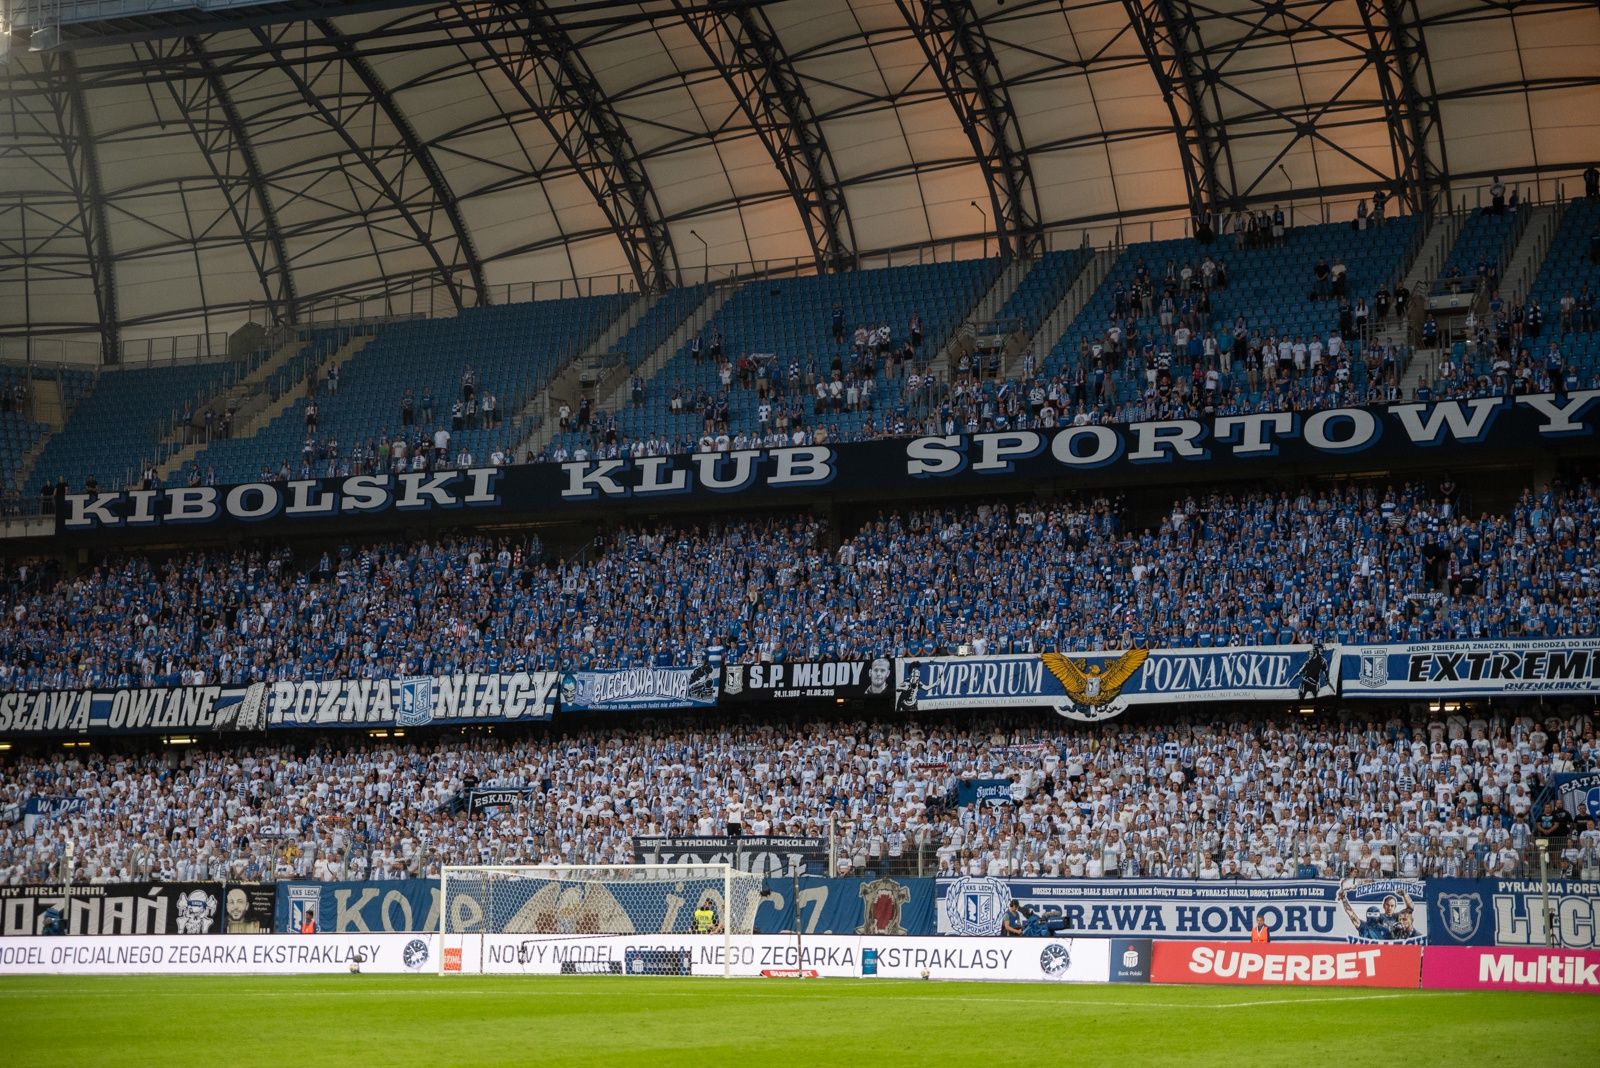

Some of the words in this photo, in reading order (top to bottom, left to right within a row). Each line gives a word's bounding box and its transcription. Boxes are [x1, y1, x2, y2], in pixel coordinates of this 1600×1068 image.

[64, 467, 499, 526] KIBOLSKI
[560, 446, 833, 497] KLUB
[907, 389, 1600, 476] SPORTOWY
[1473, 643, 1510, 651] ZNACZKI,
[749, 664, 785, 689] S.P.
[792, 662, 865, 687] MŁODY
[926, 660, 1043, 697] IMPERIUM
[1139, 652, 1291, 691] POZNAŃSKIE
[656, 670, 688, 701] KLIKA
[0, 691, 92, 734] SŁAWĄ
[107, 686, 221, 728] OWIANE
[1559, 775, 1600, 794] RATA
[474, 793, 518, 808] ESKADR
[675, 839, 728, 847] STADIONU
[292, 889, 303, 897] KKS
[305, 888, 318, 897] LECH
[1308, 887, 1325, 896] LECH
[1567, 882, 1600, 894] FORE
[0, 887, 168, 935] OZNAŃ
[1176, 905, 1337, 934] HONORU
[0, 947, 45, 964] ODEL
[52, 946, 163, 964] OFICJALNEGO
[169, 946, 247, 964] ZEGARKA
[254, 945, 380, 964] EKSTRAKLASY
[489, 945, 548, 963] NOWY
[760, 946, 854, 966] ZEGARKA
[1188, 946, 1381, 982] SUPERBET
